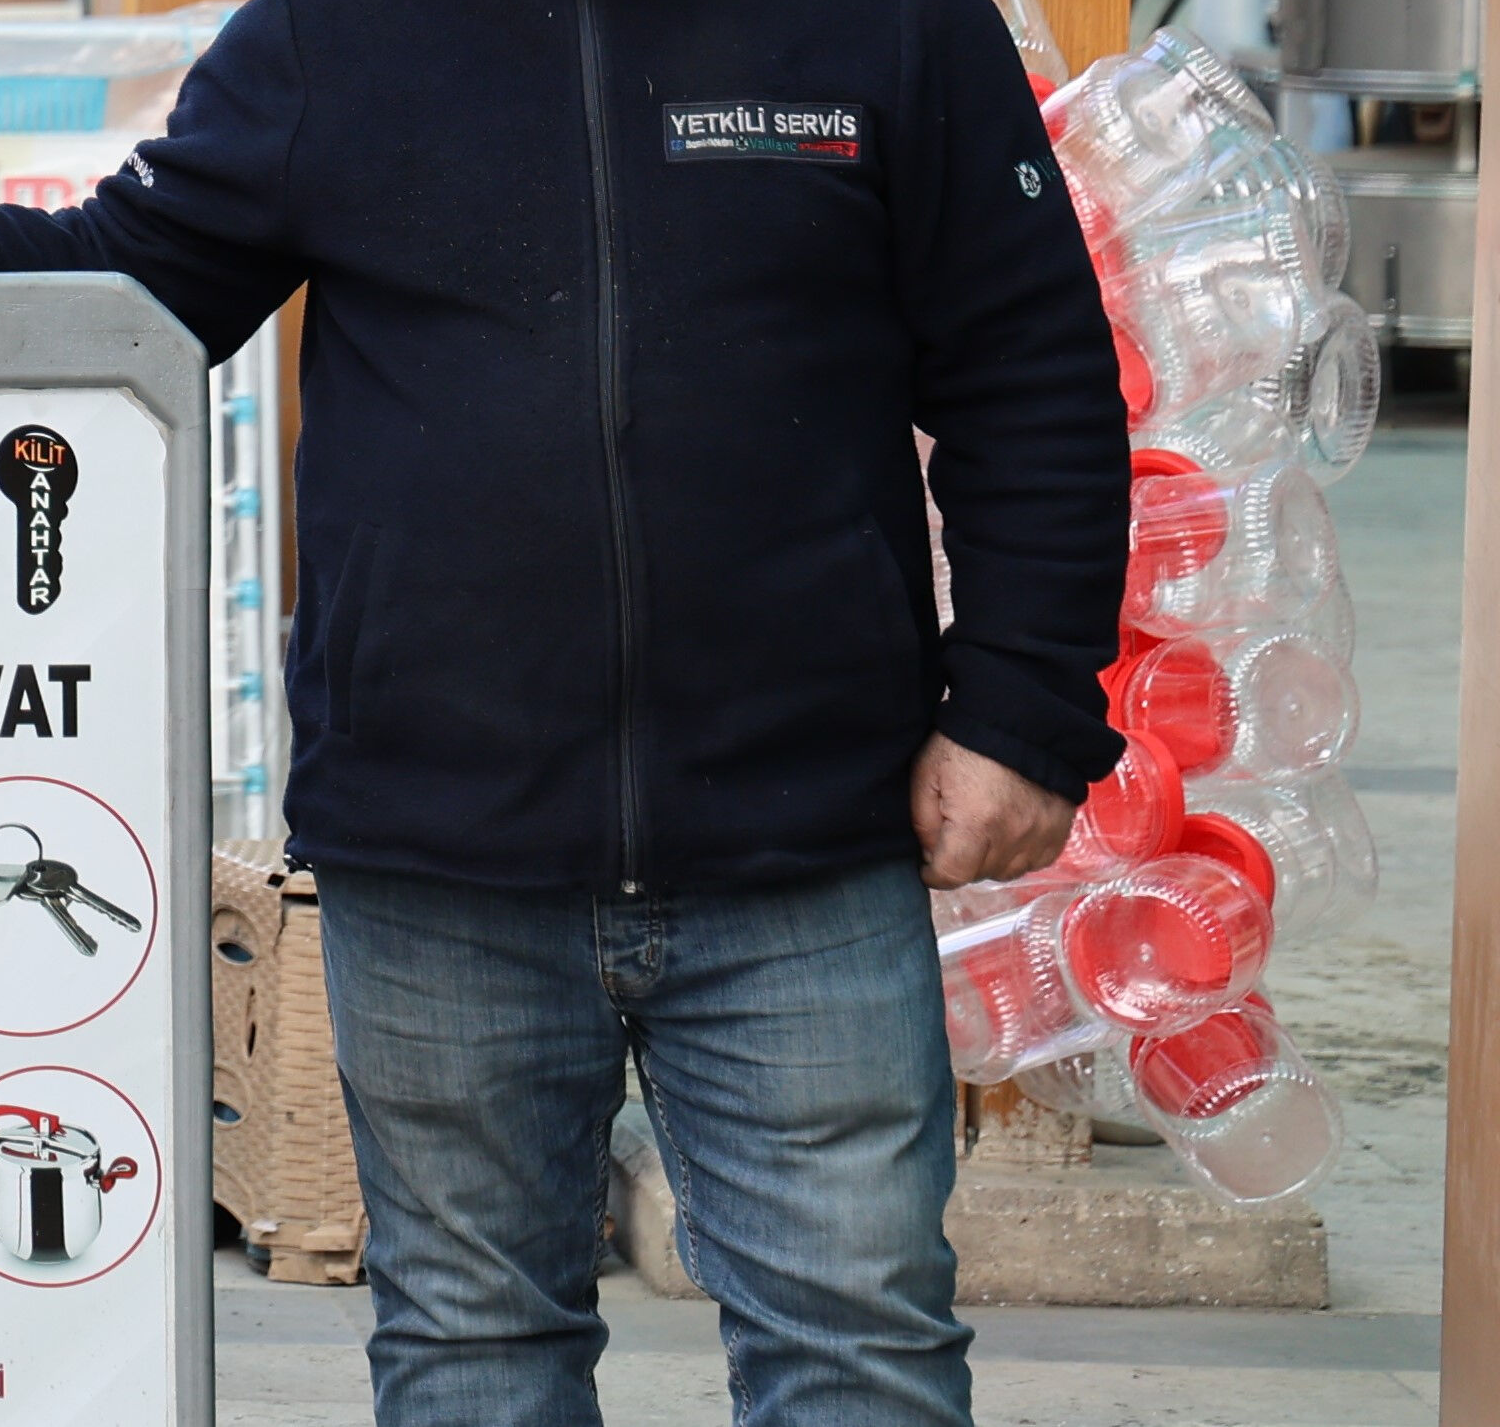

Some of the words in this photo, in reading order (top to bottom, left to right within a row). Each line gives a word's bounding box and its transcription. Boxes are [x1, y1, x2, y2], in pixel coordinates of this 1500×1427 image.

[671, 107, 765, 135] YETKİLİ
[774, 109, 857, 136] SERVİS
[14, 437, 66, 465] KİLİT
[29, 472, 51, 606] ANAHTAR
